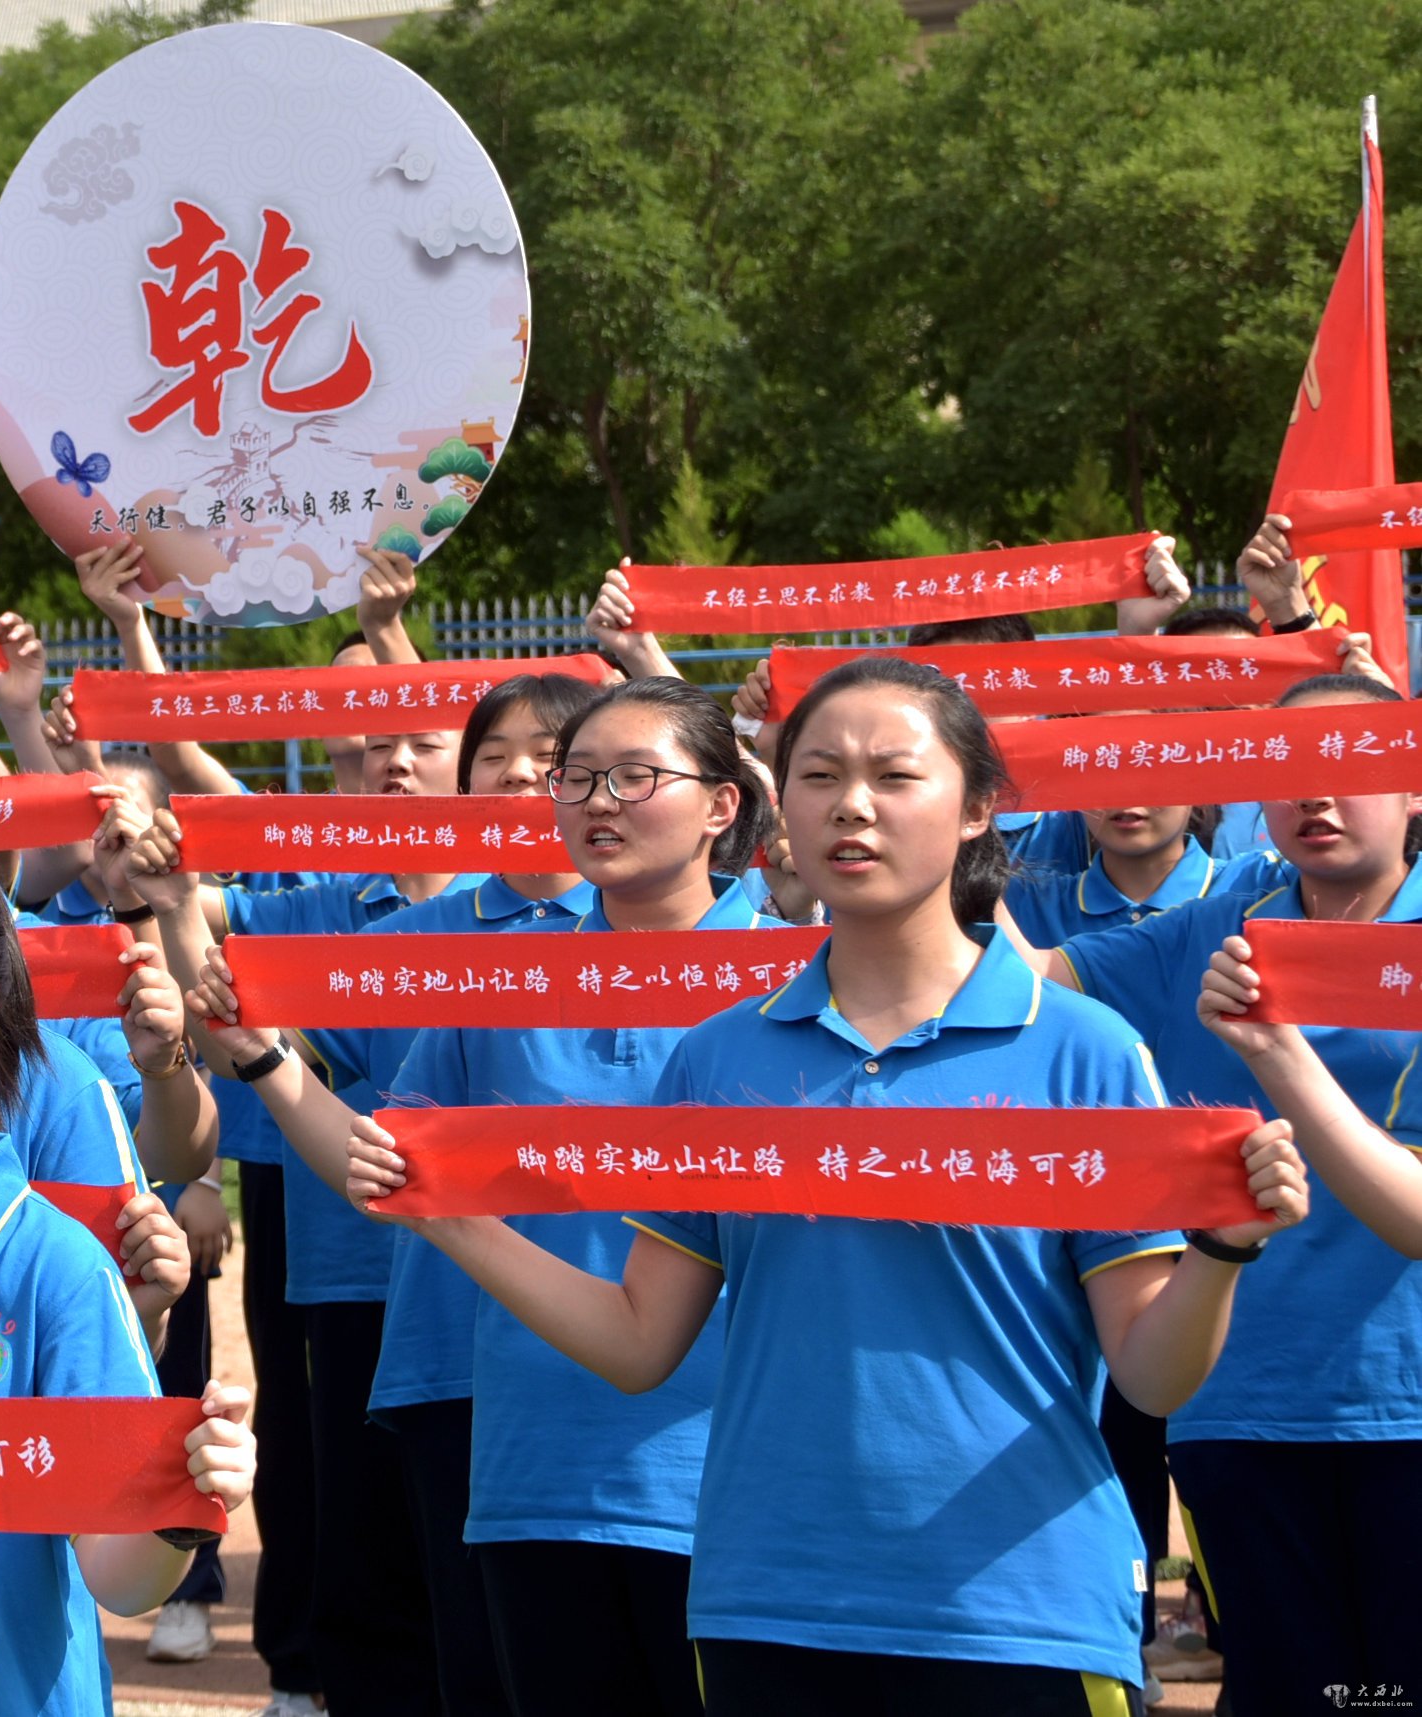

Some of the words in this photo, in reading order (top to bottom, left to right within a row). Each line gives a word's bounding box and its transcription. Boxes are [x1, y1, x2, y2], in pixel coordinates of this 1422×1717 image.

[125, 199, 373, 438] 乾
[702, 581, 875, 609] 不经三思不求教
[892, 564, 1064, 600] 不动笔墨不读书
[1058, 657, 1259, 688] 不动笔墨不读书
[150, 689, 325, 718] 不经三思不求教
[1063, 734, 1291, 772] 脚踏实地山让路
[1318, 729, 1417, 760] 持之以
[264, 822, 458, 848] 脚踏实地山让路
[480, 823, 563, 849] 持之以
[328, 965, 551, 998] 脚踏实地山让路
[576, 959, 807, 995] 持之以恒海可移
[516, 1142, 786, 1177] 脚踏实地山让路
[817, 1143, 1107, 1186] 持之以恒海可移
